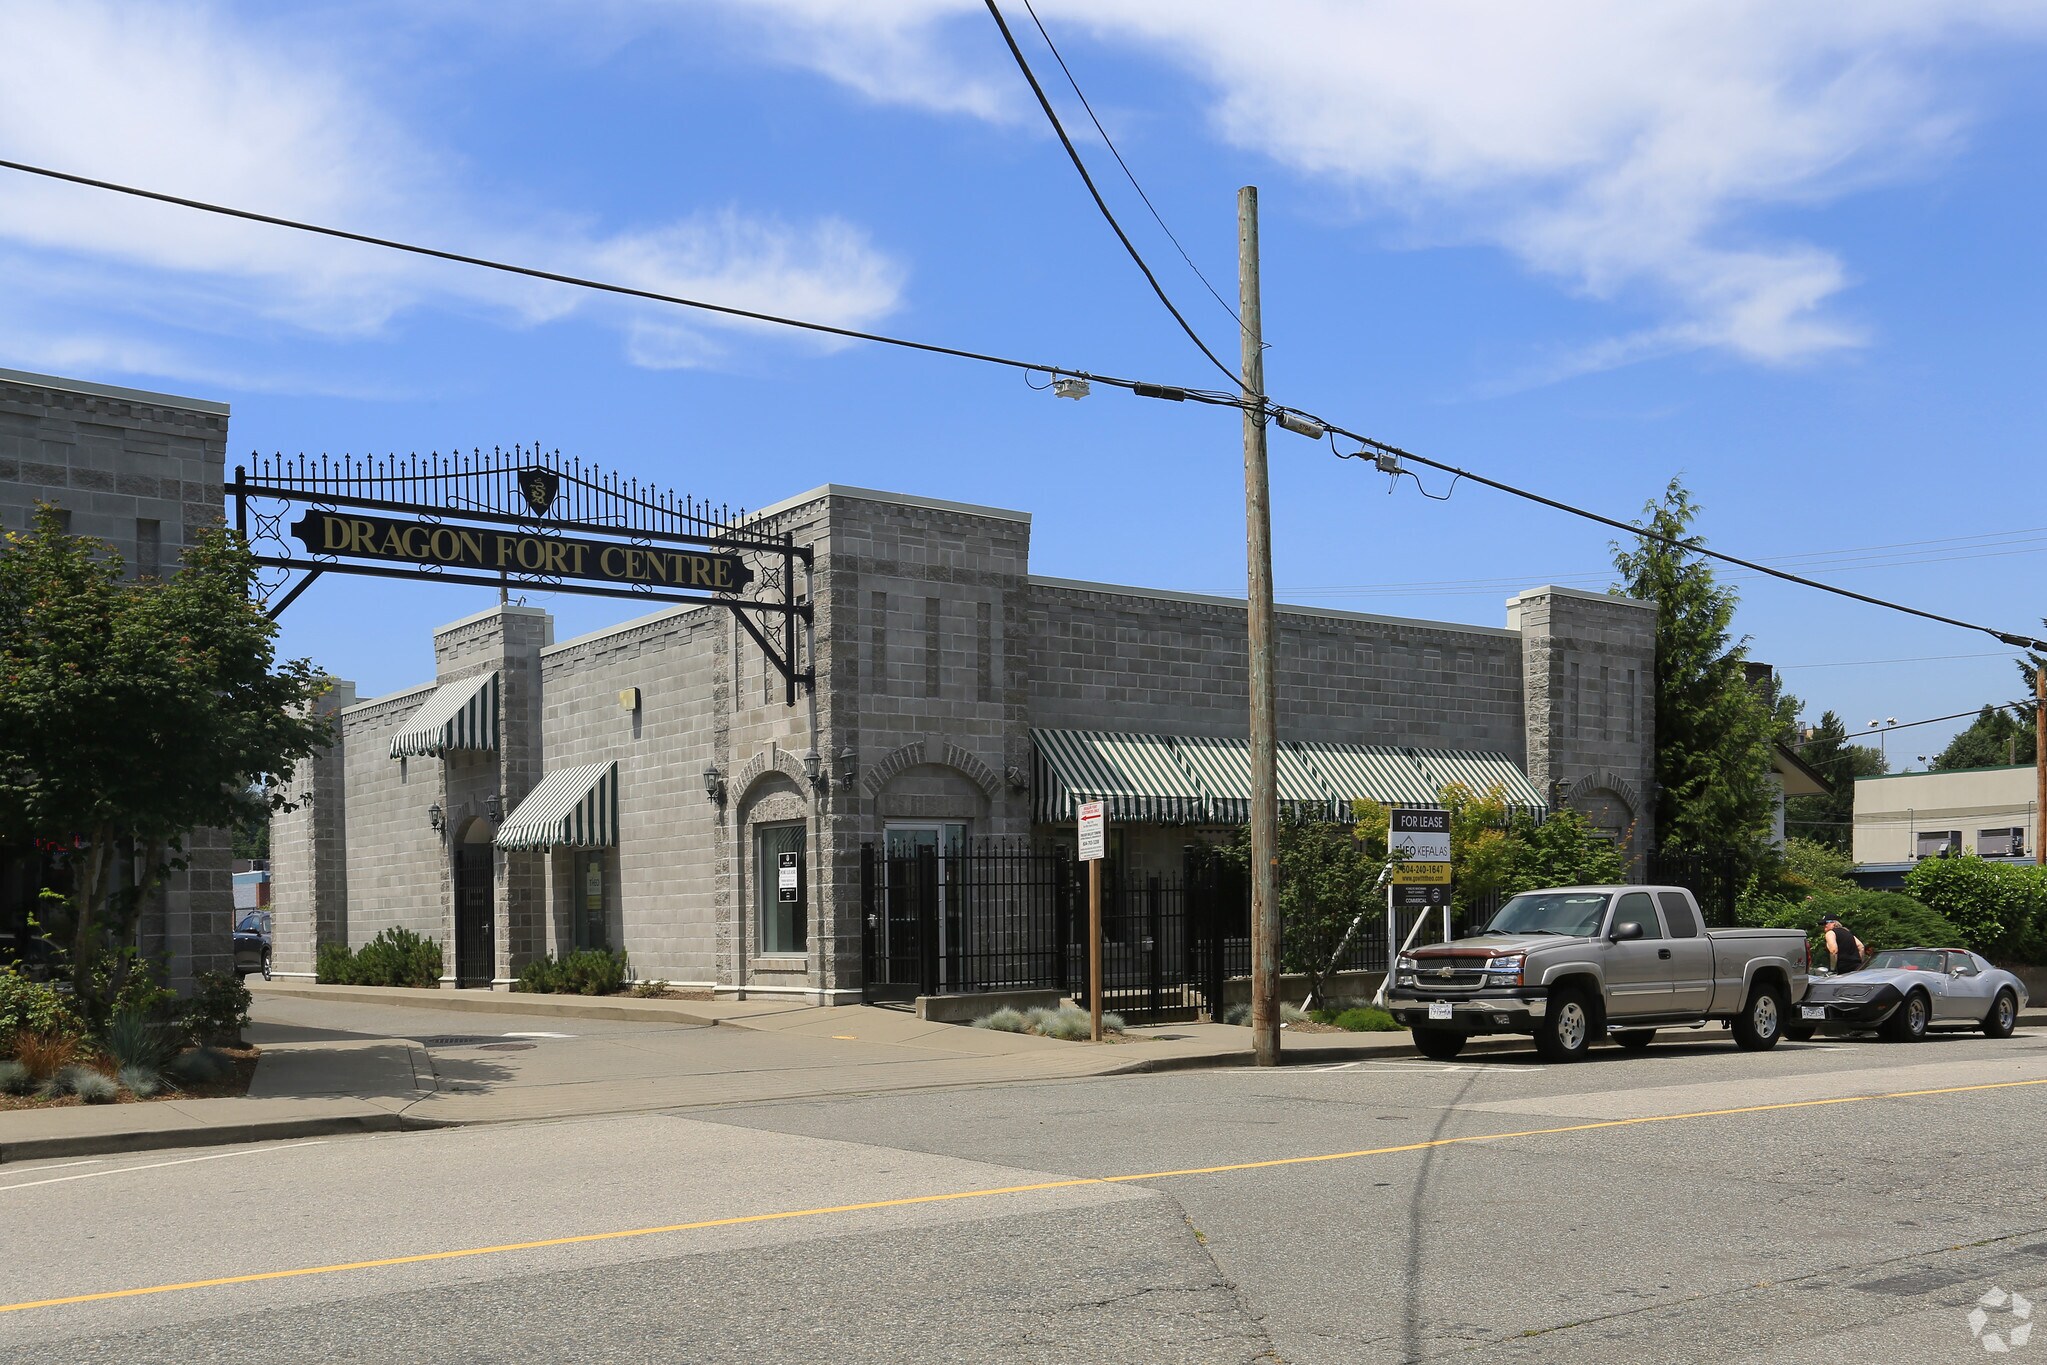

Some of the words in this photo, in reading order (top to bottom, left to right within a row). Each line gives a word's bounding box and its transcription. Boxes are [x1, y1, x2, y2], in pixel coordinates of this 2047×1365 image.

[322, 516, 484, 564] DRAGON
[496, 535, 590, 574] FORT
[600, 546, 733, 588] CENTRE
[1401, 815, 1418, 827] FOR
[1420, 816, 1443, 828] LEASE
[1417, 845, 1448, 858] KEFALAS
